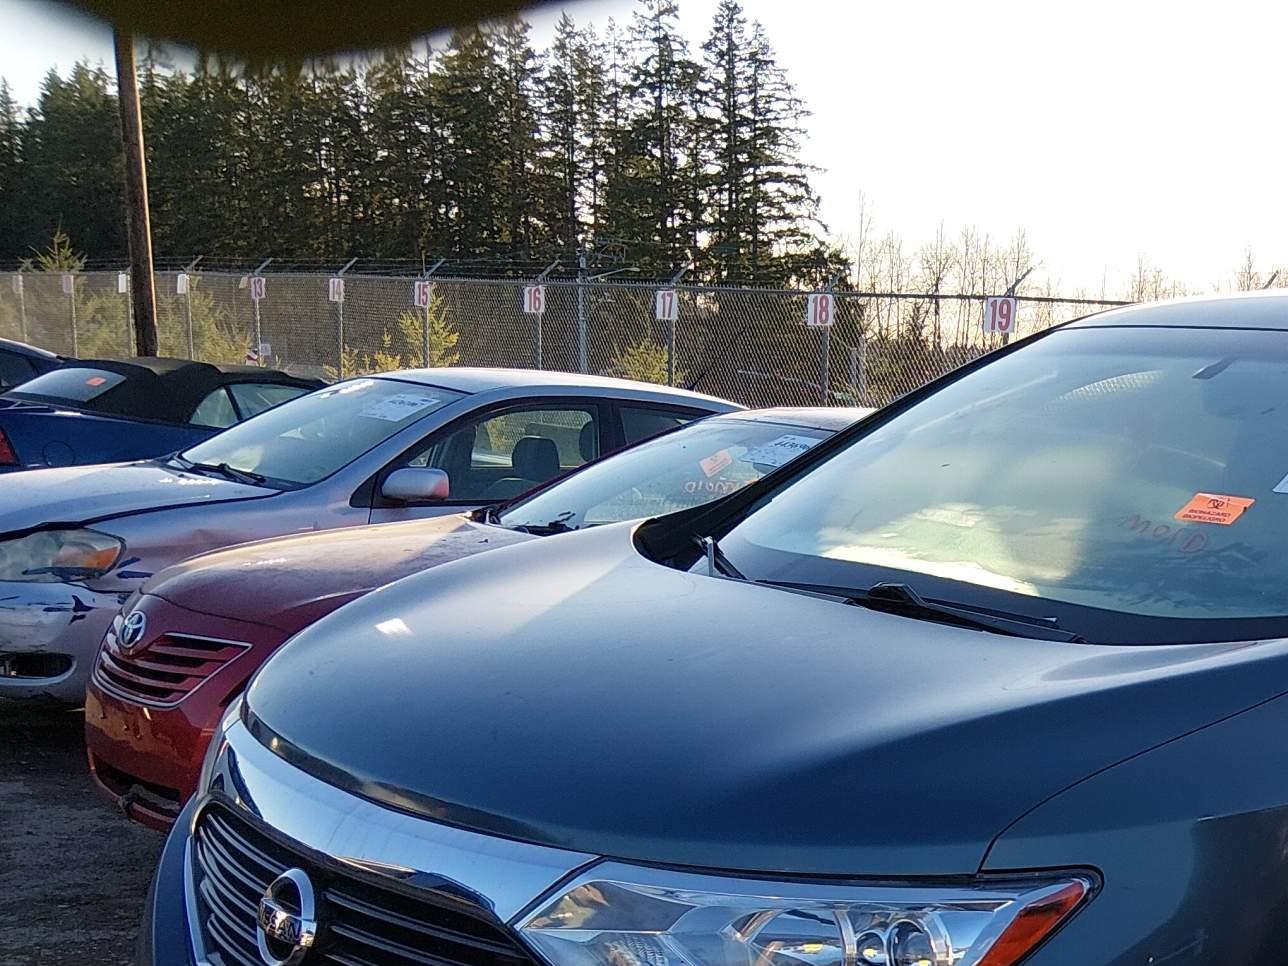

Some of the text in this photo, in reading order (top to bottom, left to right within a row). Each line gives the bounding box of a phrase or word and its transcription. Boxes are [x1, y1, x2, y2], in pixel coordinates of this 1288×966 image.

[253, 278, 262, 297] 13
[332, 279, 341, 299] 14
[418, 283, 429, 306] 15
[528, 287, 541, 311] 16
[661, 292, 674, 318] 17
[813, 295, 829, 324] 18
[991, 299, 1011, 331] 19
